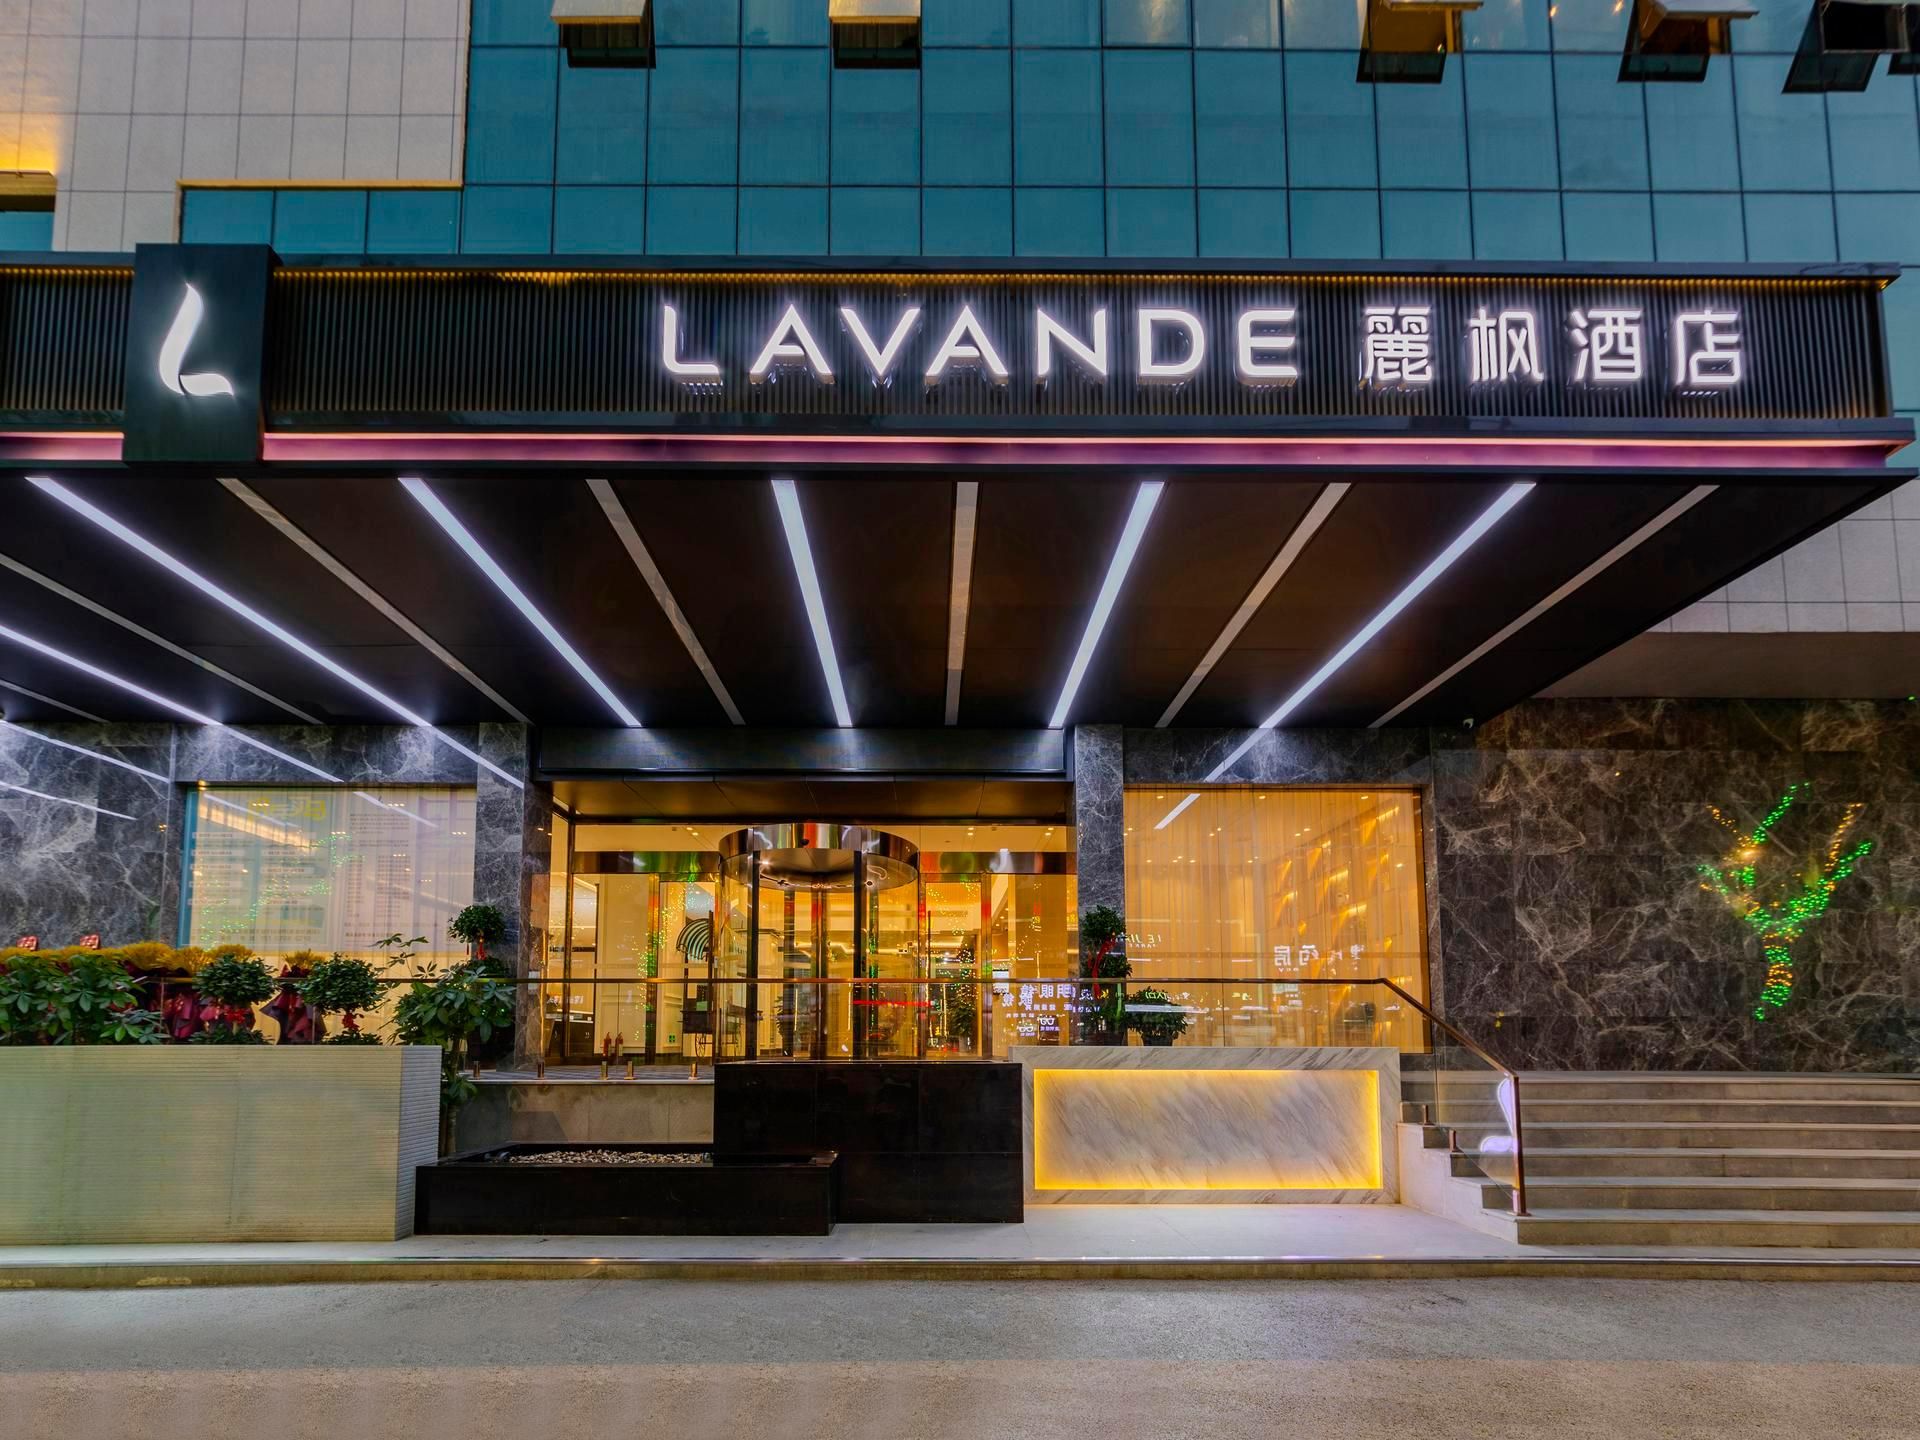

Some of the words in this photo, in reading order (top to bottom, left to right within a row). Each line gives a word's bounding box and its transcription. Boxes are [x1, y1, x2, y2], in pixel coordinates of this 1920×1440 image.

[662, 304, 1299, 378] LAVANDE
[1364, 305, 1744, 386] 麗枫酒店
